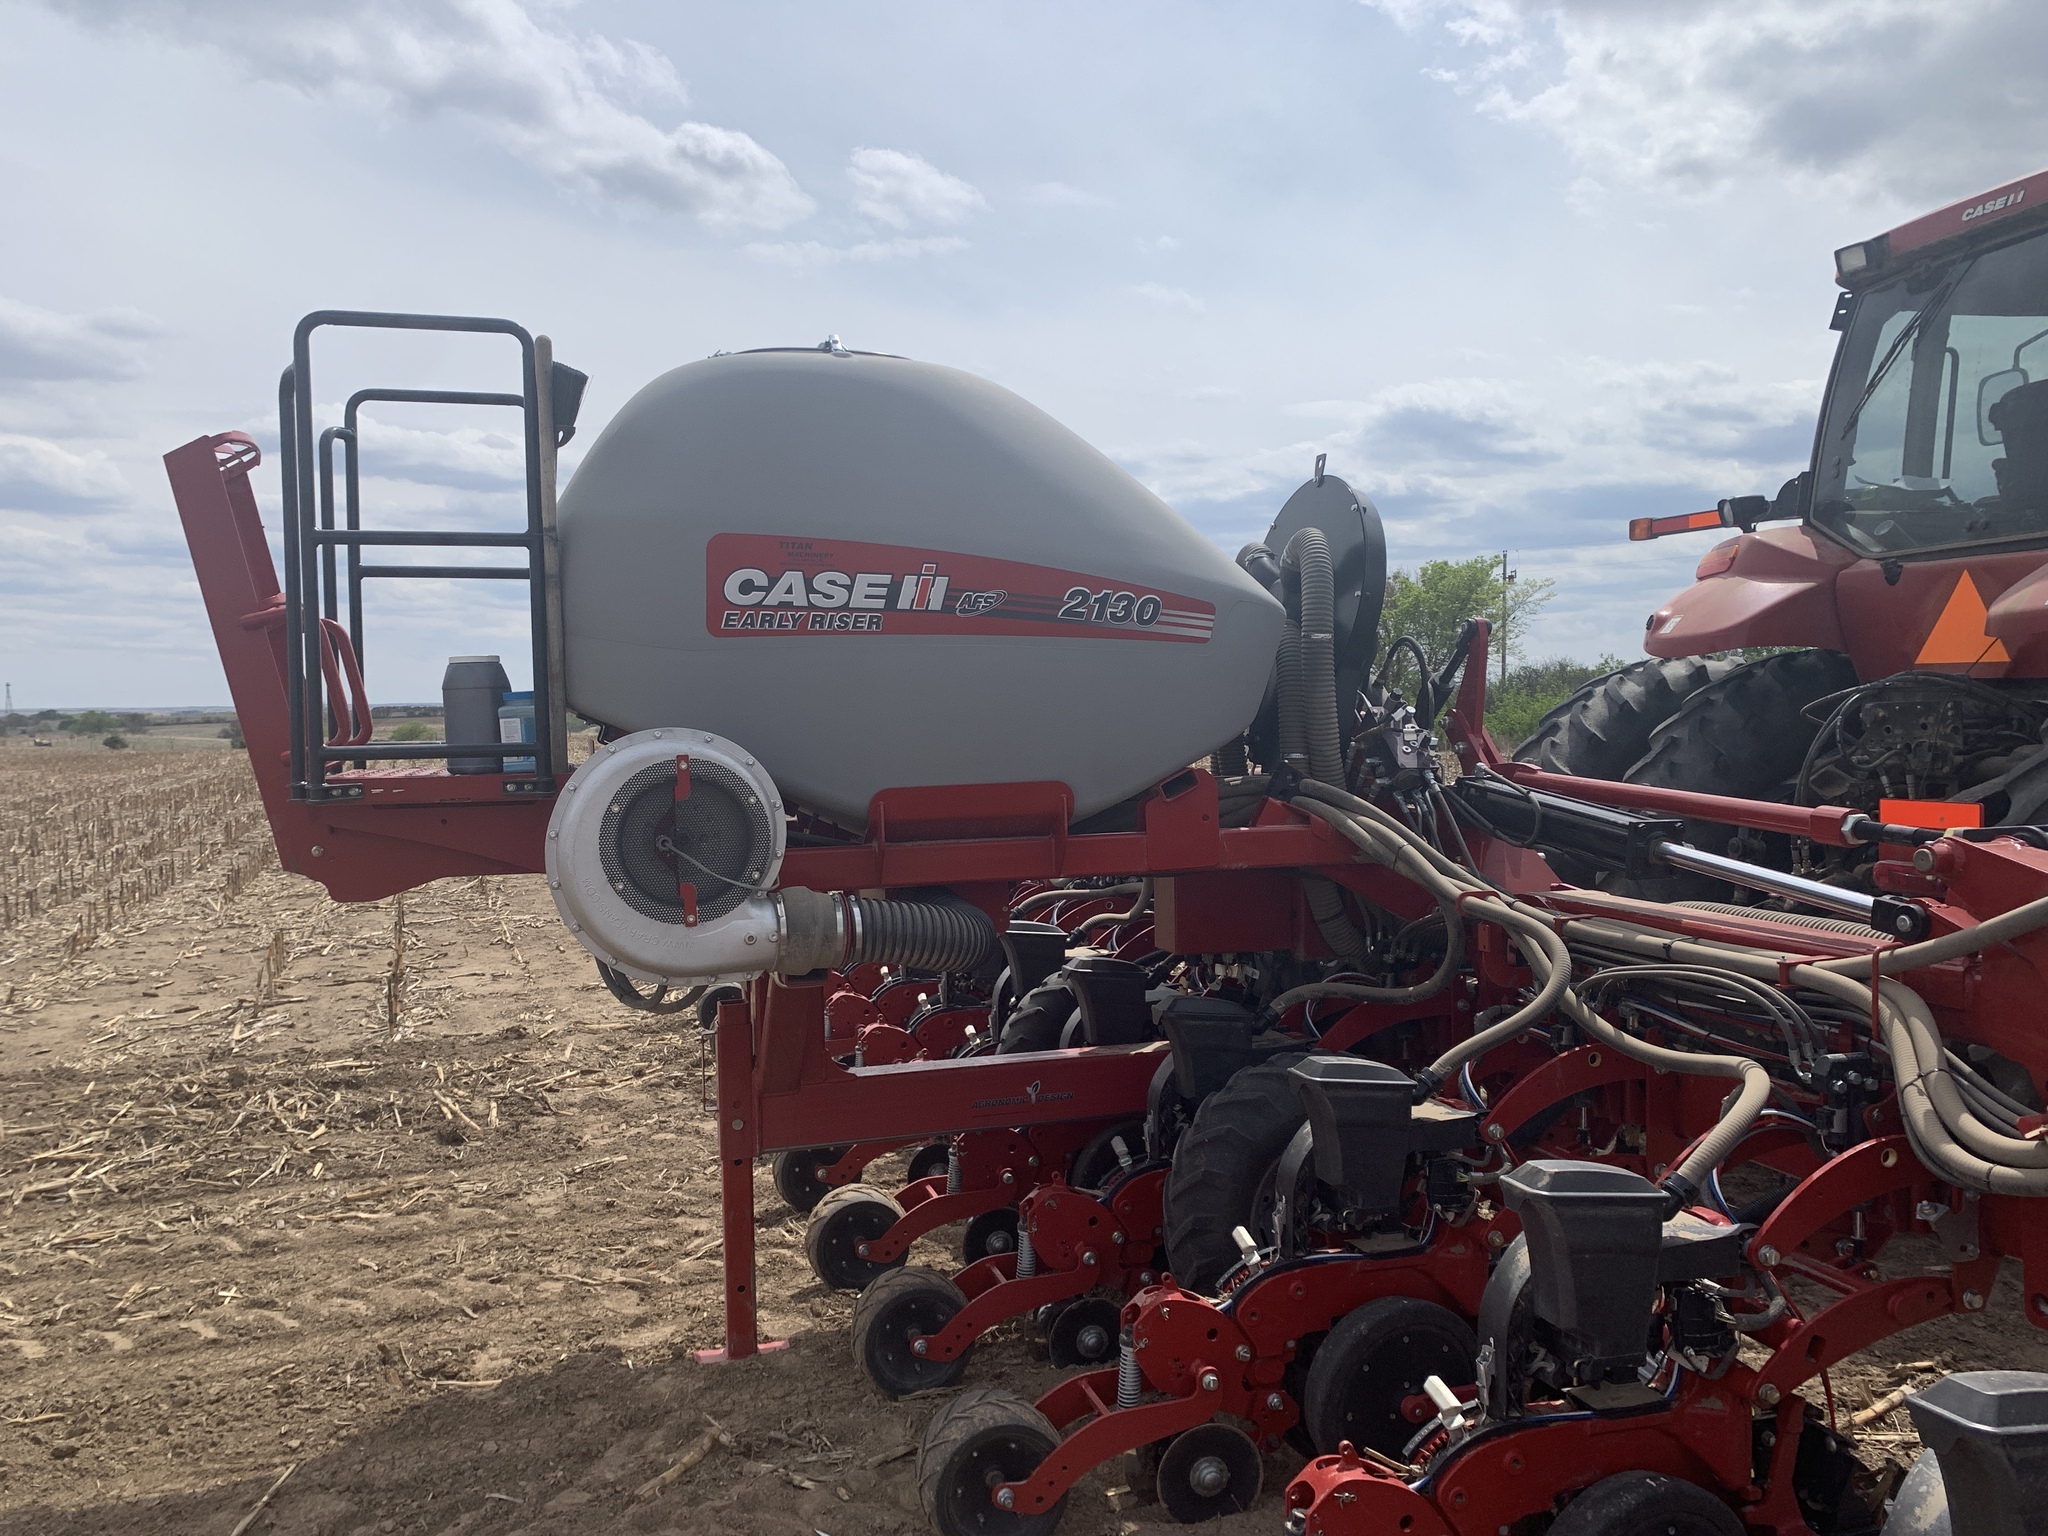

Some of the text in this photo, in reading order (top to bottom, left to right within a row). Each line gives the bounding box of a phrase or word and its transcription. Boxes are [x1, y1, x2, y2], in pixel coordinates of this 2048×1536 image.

[1961, 195, 2008, 221] CASE
[779, 541, 813, 550] TITAN
[787, 551, 835, 559] MACHINERY
[723, 568, 893, 609] CASE
[954, 591, 998, 610] AFS
[1057, 586, 1163, 628] 2130
[720, 610, 884, 632] EARLY RISER
[971, 1091, 1075, 1109] AGRONOMIC DESIGN
